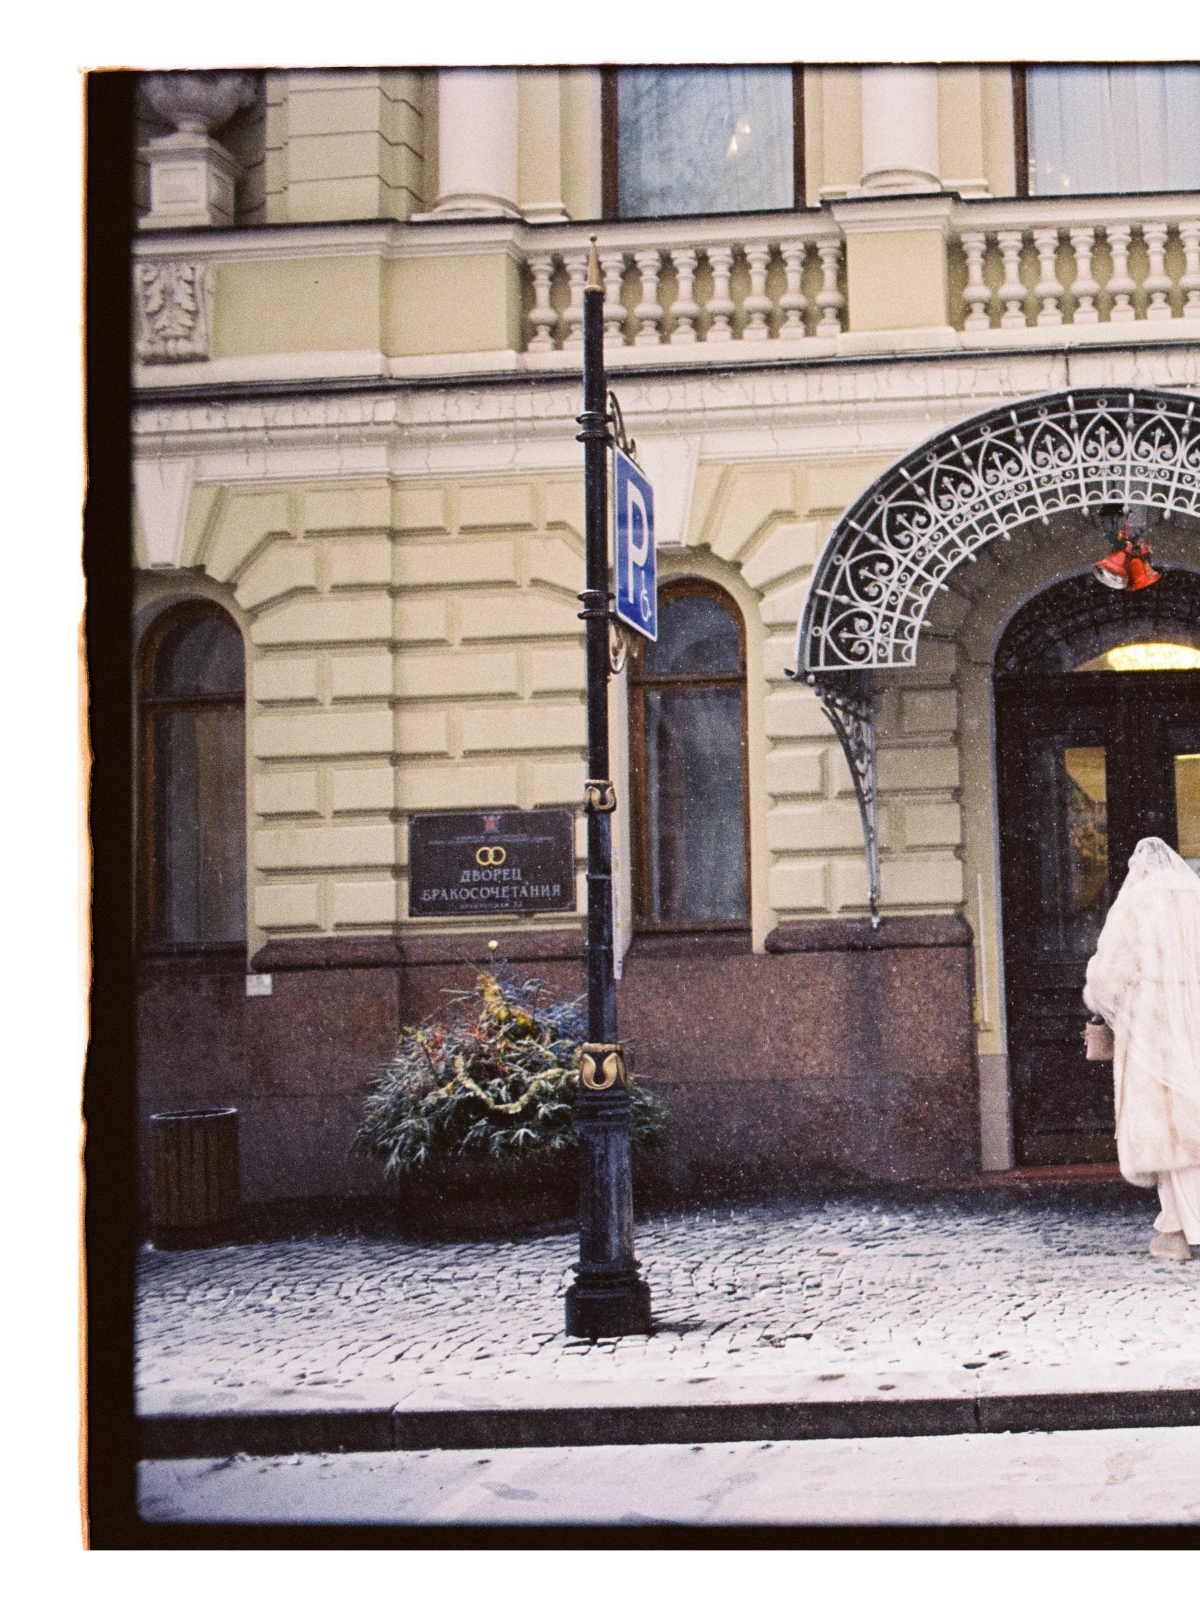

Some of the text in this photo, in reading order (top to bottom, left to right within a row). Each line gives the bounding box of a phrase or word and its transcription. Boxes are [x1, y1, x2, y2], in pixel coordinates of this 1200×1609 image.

[627, 479, 649, 604] P
[460, 868, 522, 883] ДВОРЕЦ
[422, 884, 561, 901] БРАКОСОЧЕТАНИЯ
